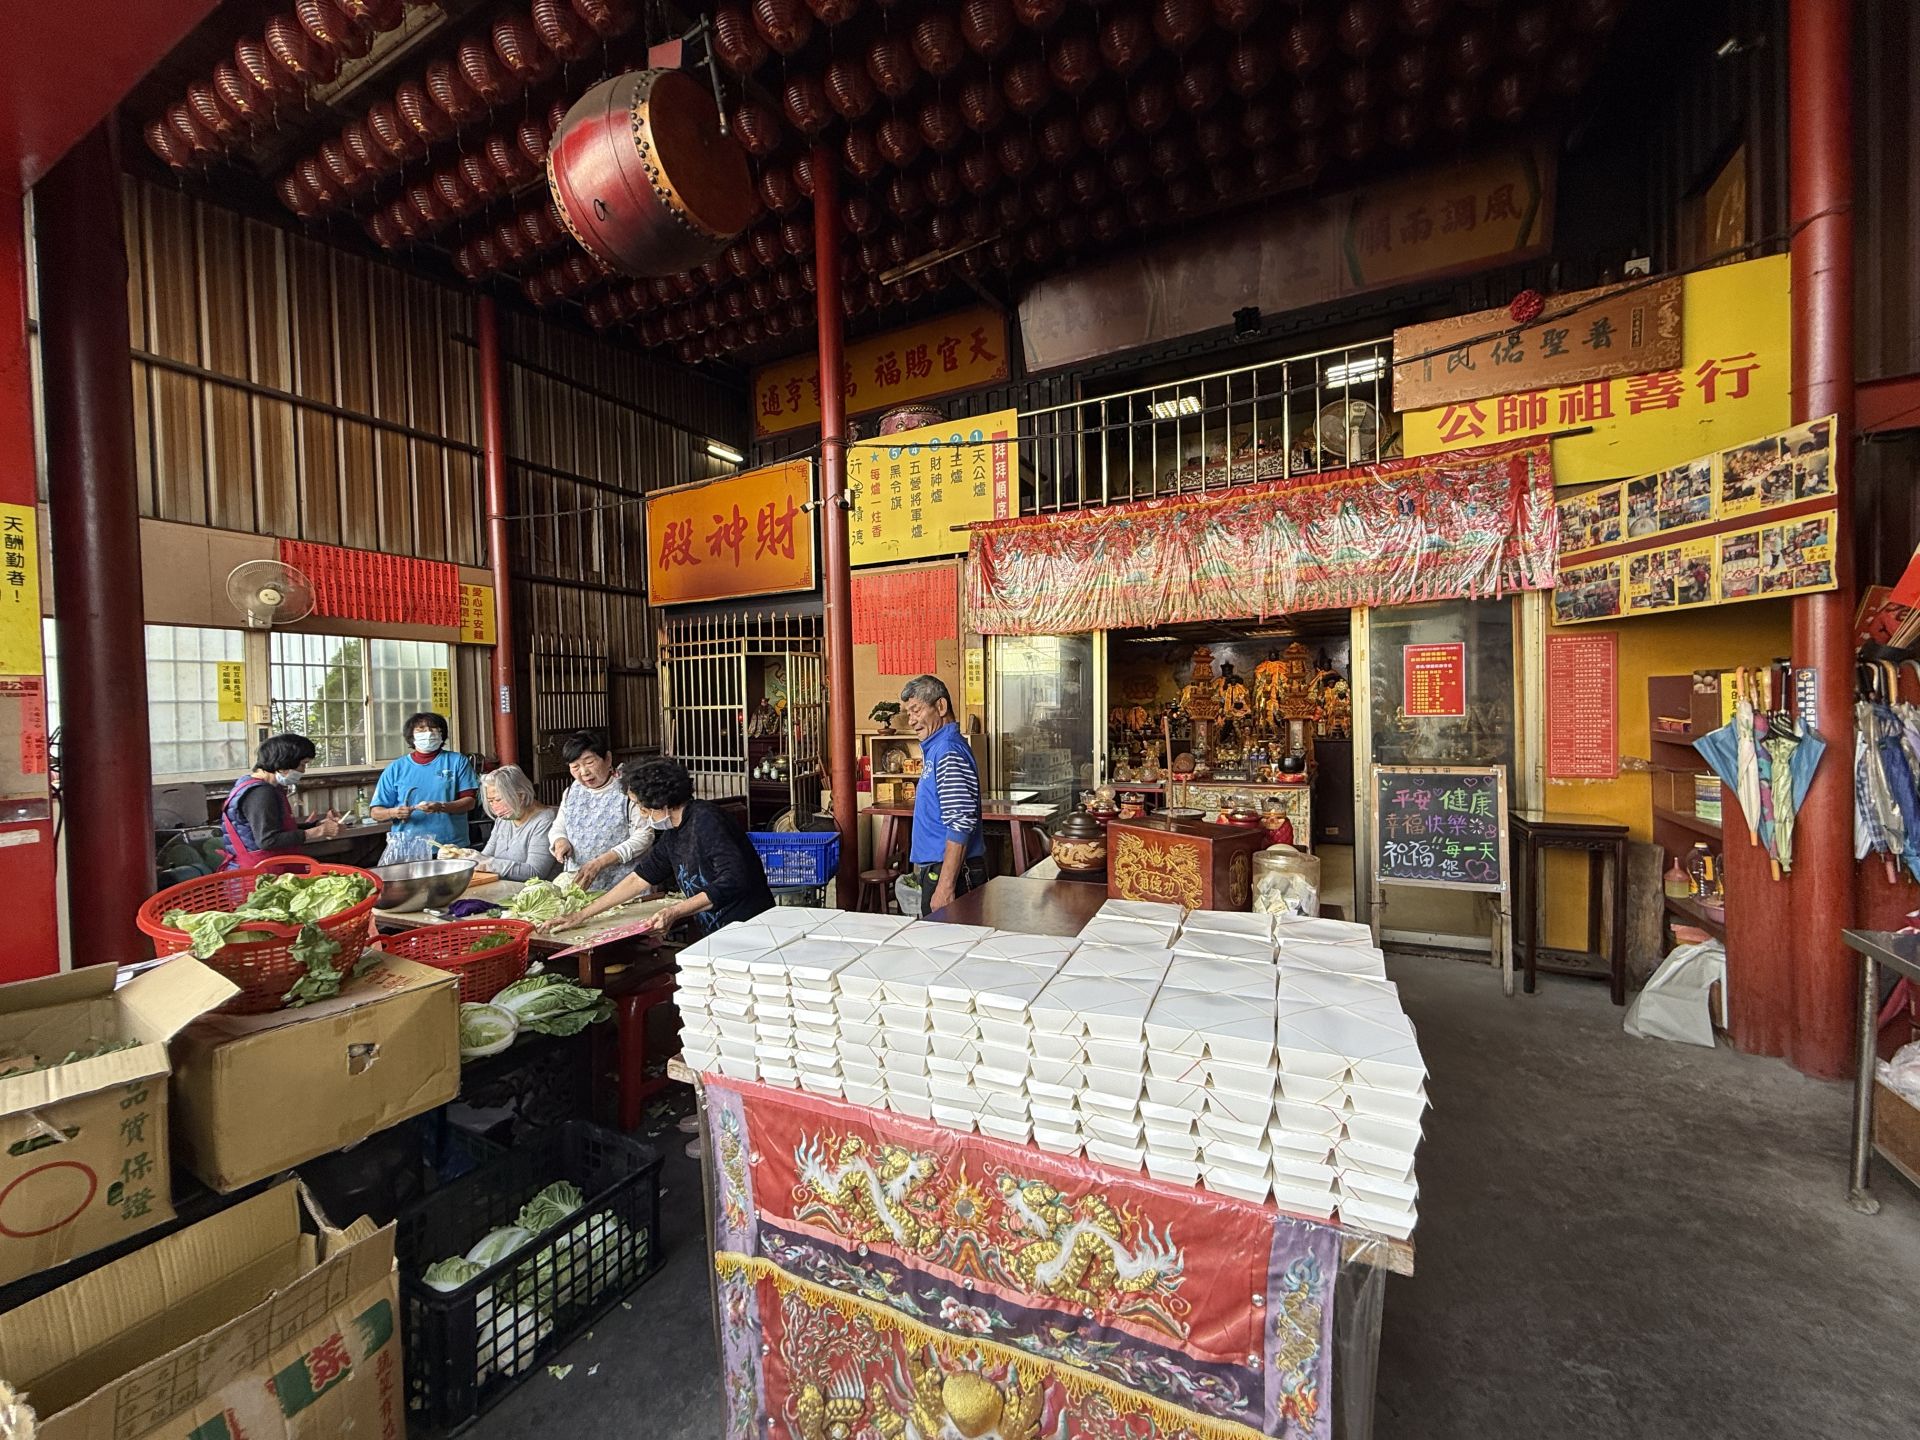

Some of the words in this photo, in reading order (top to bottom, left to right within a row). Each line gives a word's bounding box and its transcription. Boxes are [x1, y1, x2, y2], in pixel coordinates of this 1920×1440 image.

[1359, 183, 1522, 254] 風調雨順
[873, 325, 998, 388] 天官賜福
[1436, 353, 1761, 444] 行善祖師公
[850, 458, 864, 546] 行善積德
[889, 464, 902, 511] 黑令旗
[909, 459, 923, 539] 五營將軍爐
[930, 456, 943, 504] 財神爐
[972, 449, 986, 498] 天公爐
[994, 441, 1007, 520] 拜拜順序
[658, 493, 799, 572] 財神殿
[1385, 812, 1468, 839] 幸福快樂
[1391, 787, 1432, 812] 平安
[1438, 787, 1495, 818] 健康
[1382, 840, 1435, 869] 祝福
[1441, 838, 1497, 862] 每一天
[1438, 858, 1466, 878] 您
[119, 1081, 156, 1221] 品質保證
